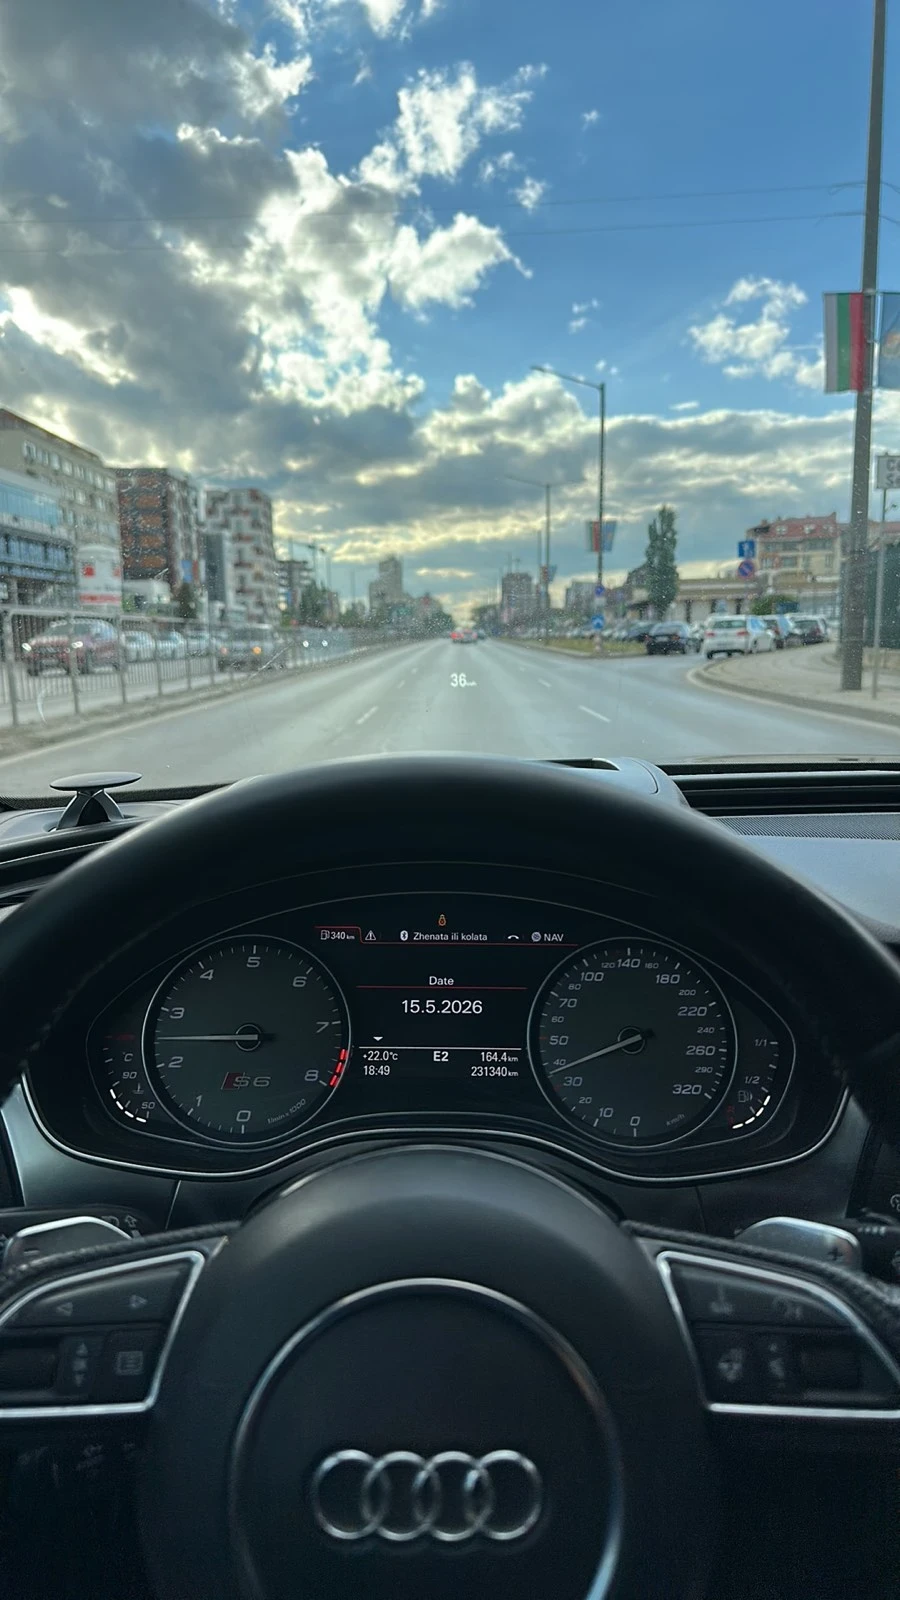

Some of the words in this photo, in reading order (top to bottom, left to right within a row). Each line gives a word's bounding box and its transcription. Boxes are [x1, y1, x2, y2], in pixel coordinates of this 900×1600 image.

[450, 673, 467, 687] 36
[330, 931, 346, 940] 340
[413, 931, 449, 941] Zhenata
[451, 932, 459, 941] ili
[460, 932, 488, 941] kolata
[543, 933, 564, 942] NAV
[246, 957, 260, 967] 5
[617, 958, 641, 969] 140
[201, 969, 214, 981] 4
[429, 975, 455, 986] Date
[580, 971, 605, 982] 100
[655, 973, 681, 984] 180
[292, 976, 307, 987] 6
[567, 983, 582, 991] 80
[401, 1000, 482, 1013] 15.5.2026
[559, 998, 578, 1008] 70
[169, 1008, 185, 1019] 3
[677, 1006, 708, 1017] 220
[551, 1015, 565, 1023] 60
[316, 1022, 329, 1033] 7
[696, 1026, 715, 1034] 240
[549, 1035, 569, 1046] 50
[433, 1051, 448, 1061] E2
[685, 1045, 716, 1056] 260
[167, 1056, 183, 1067] 2
[480, 1052, 507, 1062] 164.4
[553, 1057, 567, 1066] 40
[122, 1071, 138, 1080] 90
[304, 1069, 319, 1082] 8
[363, 1065, 390, 1075] 18:49
[470, 1066, 507, 1077] 231340
[694, 1066, 714, 1074] 290
[563, 1076, 583, 1087] 30
[672, 1084, 703, 1095] 320
[140, 1101, 156, 1110] 50
[195, 1095, 202, 1106] 1
[578, 1096, 593, 1104] 20
[235, 1110, 251, 1121] 0
[598, 1107, 614, 1119] 10
[629, 1116, 640, 1126] 0
